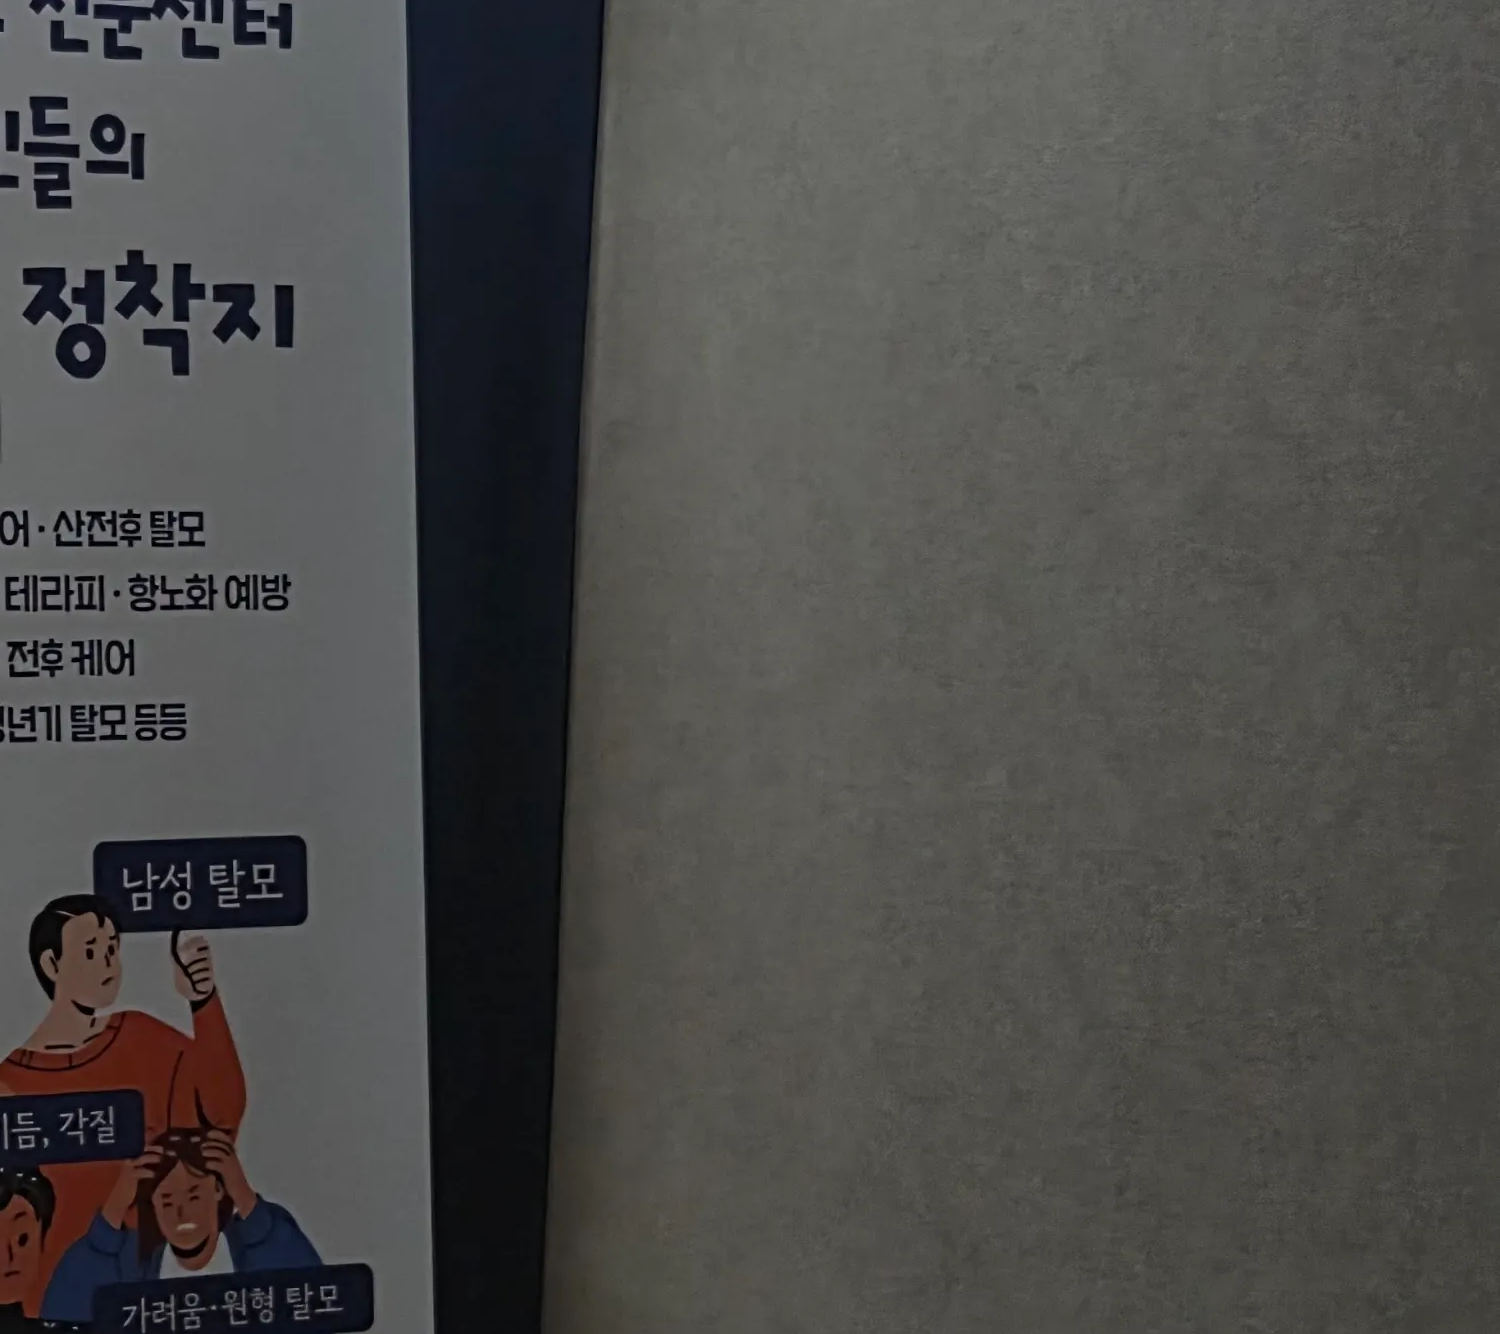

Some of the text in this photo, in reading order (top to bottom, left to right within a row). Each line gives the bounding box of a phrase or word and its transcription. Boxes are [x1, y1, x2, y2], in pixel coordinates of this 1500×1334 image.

[23, 250, 294, 379] 정착지
[149, 511, 206, 547] 탈모
[224, 574, 291, 612] 예방
[6, 638, 64, 678] 전후
[70, 639, 136, 677] 케어
[70, 706, 127, 742] 탈모
[134, 703, 188, 741] 등등
[122, 859, 283, 912] 남성 탈모
[59, 1105, 116, 1147] 각질
[285, 1285, 344, 1320] 탈모
